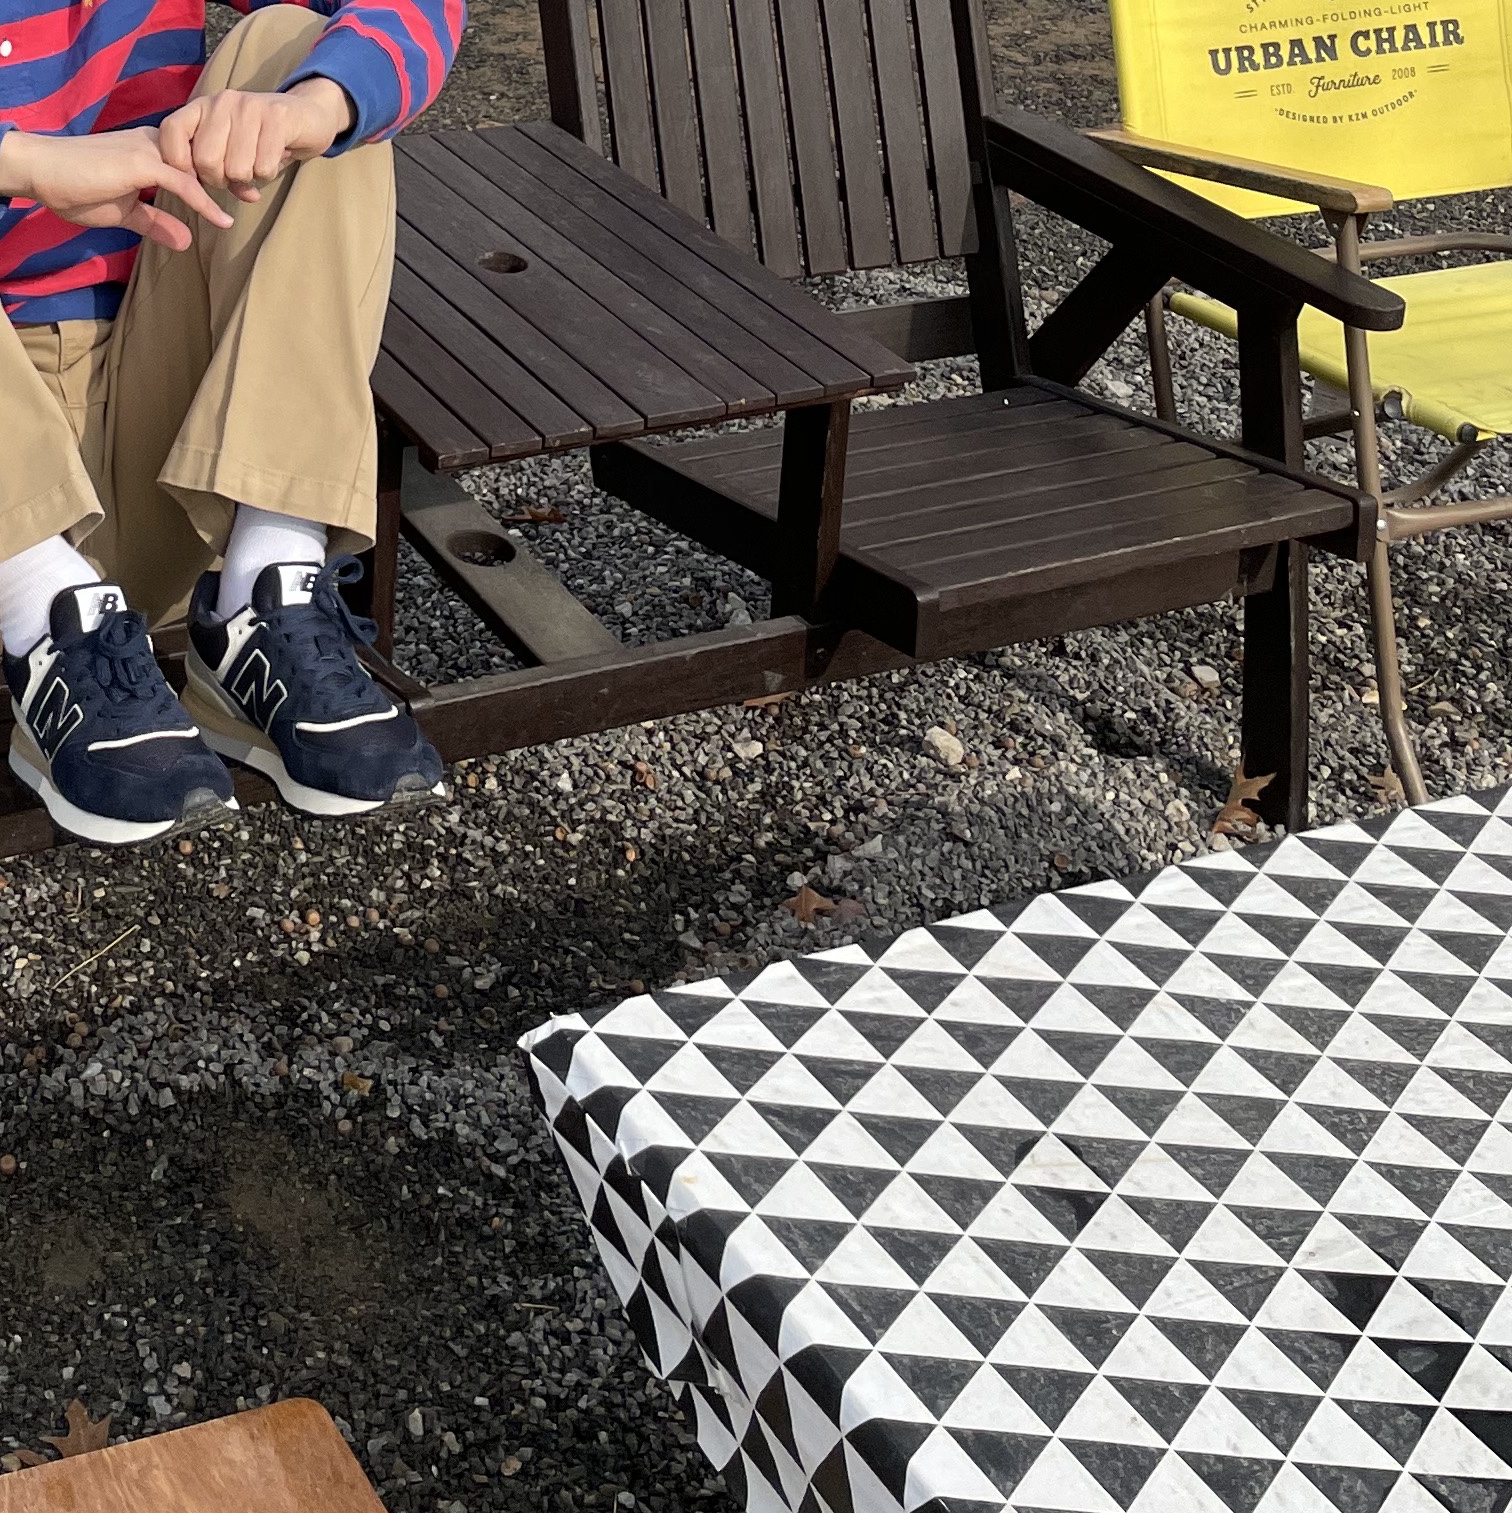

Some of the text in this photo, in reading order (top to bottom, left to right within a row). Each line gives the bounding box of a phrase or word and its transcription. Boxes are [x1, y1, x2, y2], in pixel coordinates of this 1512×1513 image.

[1239, 1, 1431, 34] CHARMING-FOLDING-LIGHT
[1208, 18, 1465, 76] URBAN CHAIR
[1308, 71, 1382, 98] Furniture
[1391, 66, 1416, 81] 2008
[1332, 114, 1344, 124] BY
[1348, 111, 1368, 123] KZM
[231, 648, 288, 735] N
[33, 676, 85, 765] N
